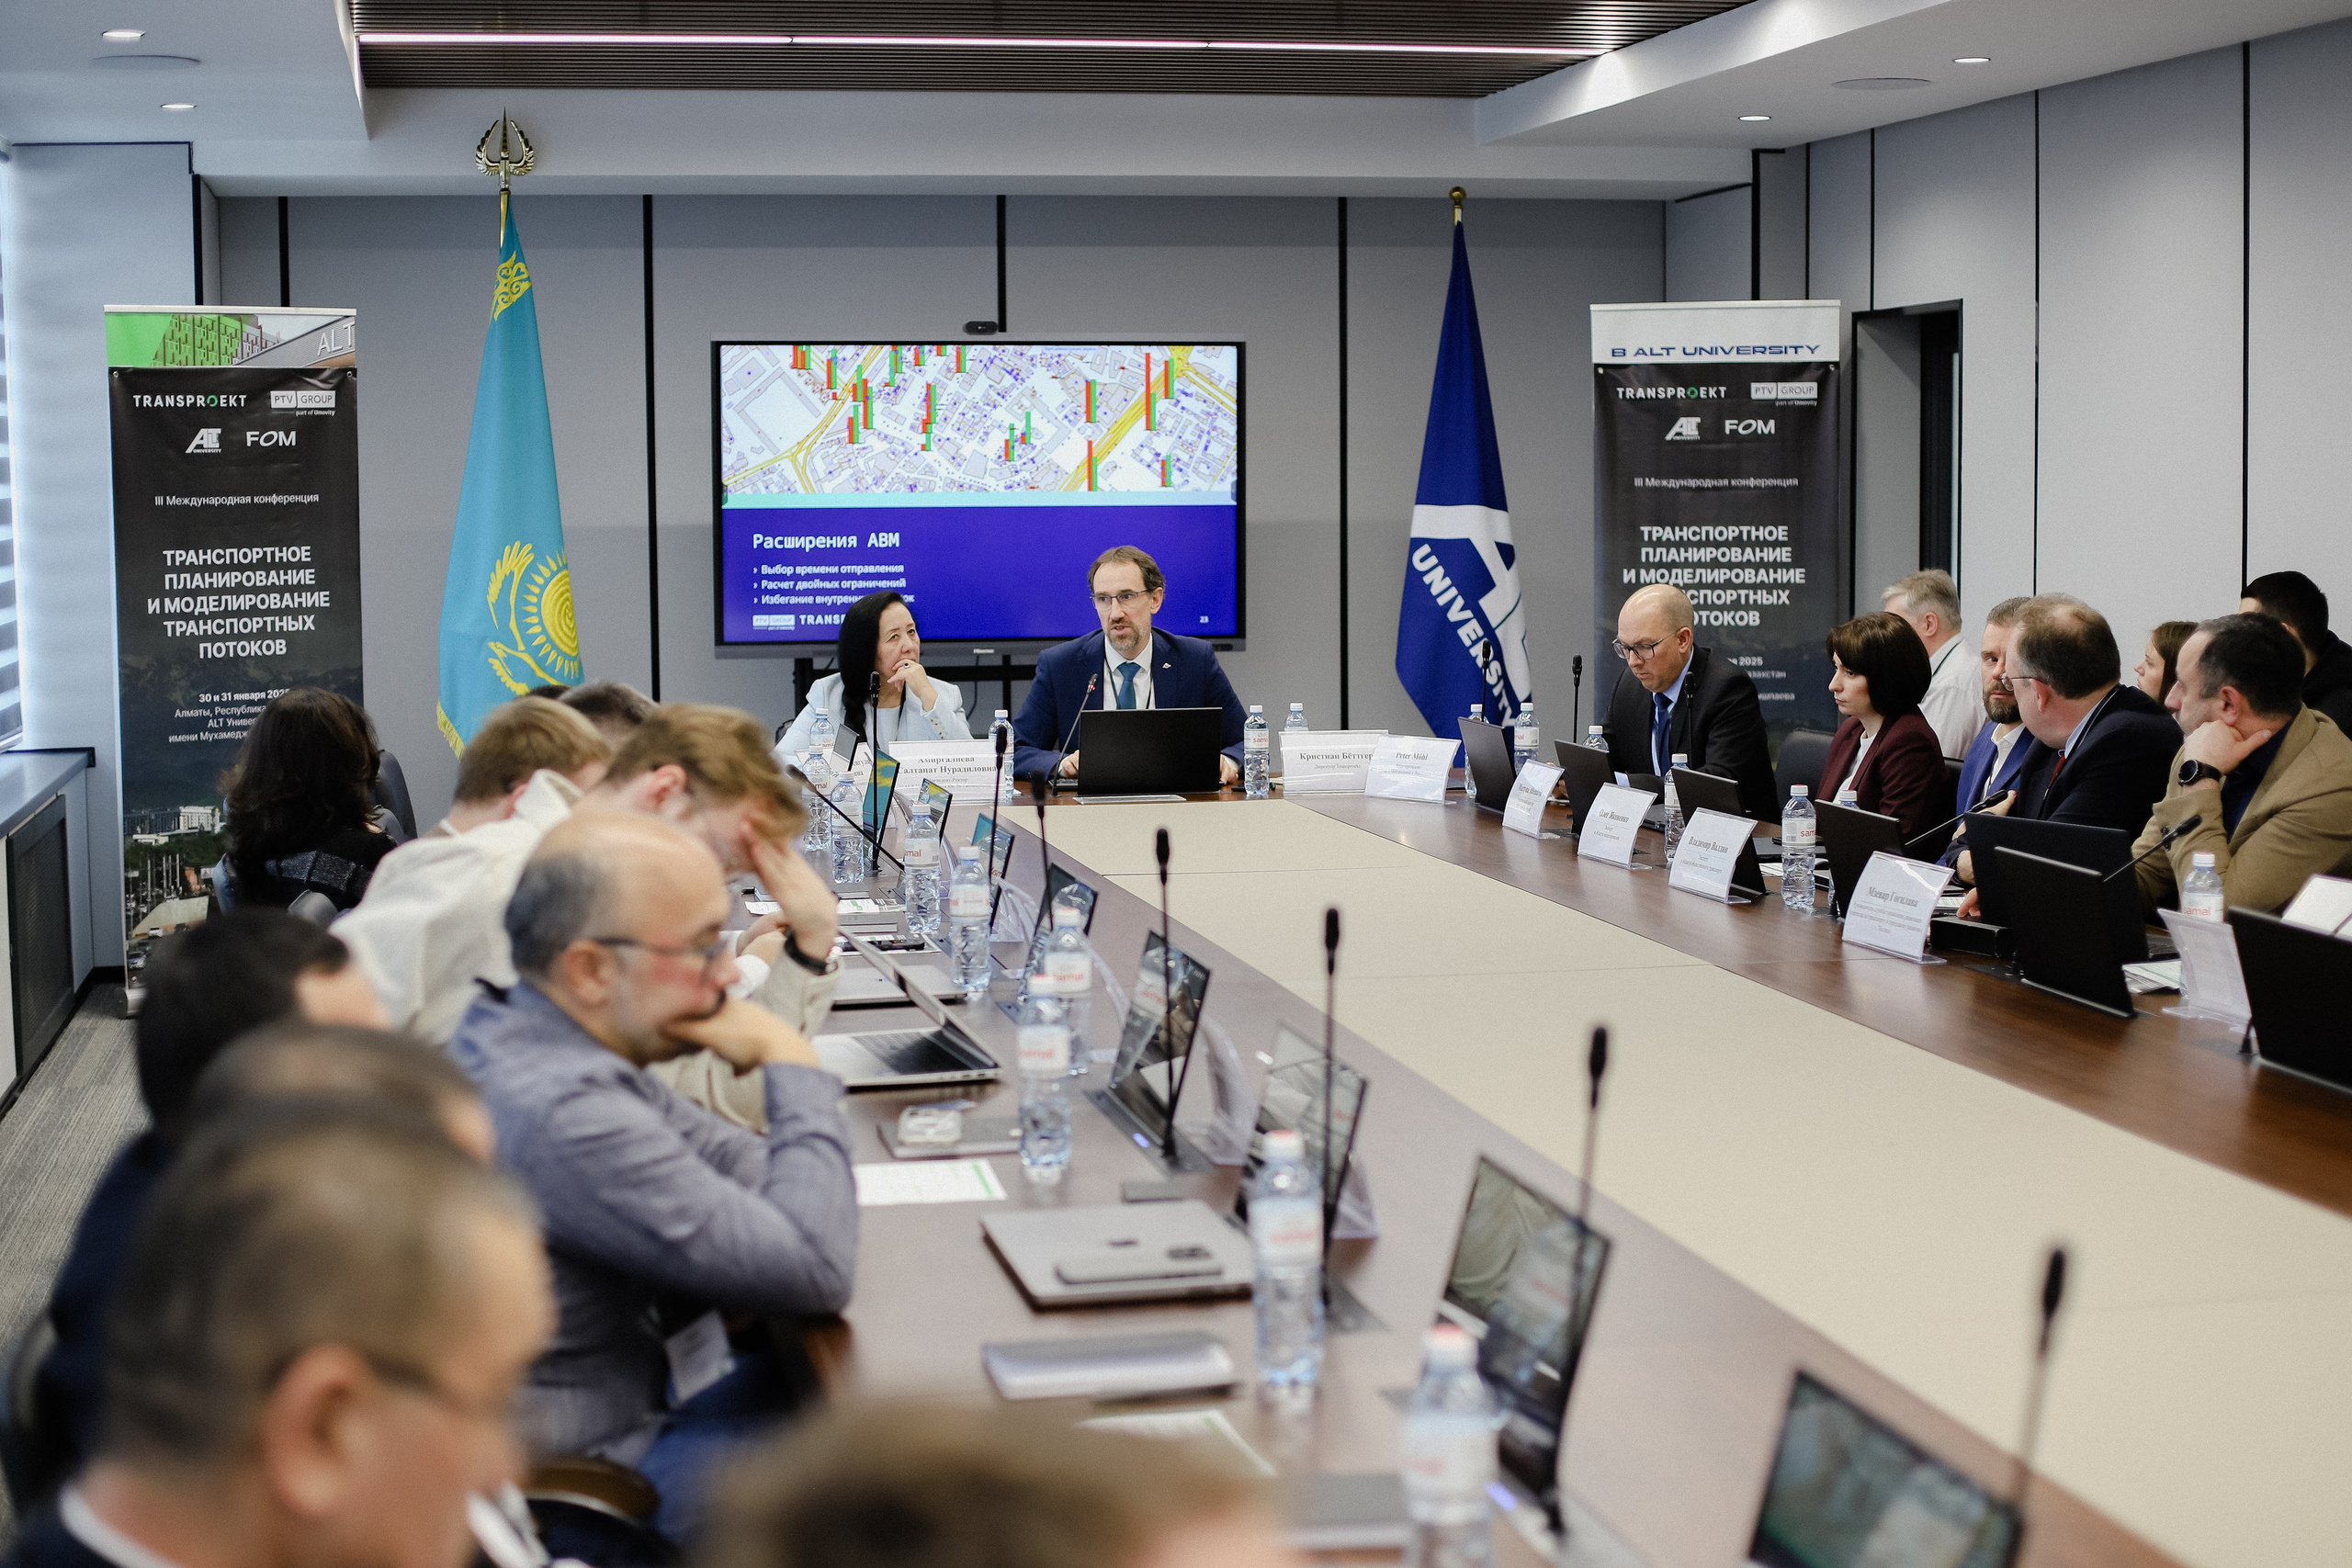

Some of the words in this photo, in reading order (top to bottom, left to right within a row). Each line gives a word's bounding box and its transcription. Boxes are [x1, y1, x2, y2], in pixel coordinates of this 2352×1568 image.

[317, 321, 355, 355] ALT
[1634, 347, 1676, 356] ALT
[1682, 344, 1820, 355] UNIVERSITY
[1617, 387, 1726, 400] TRANSPROEKT
[1755, 387, 1774, 396] PTV
[1781, 386, 1815, 395] GROUP
[133, 394, 247, 407] TRANSPROEKT
[274, 395, 293, 404] PTV
[300, 395, 333, 404] GROUP
[1724, 420, 1776, 434] FOM
[246, 431, 297, 446] FOM
[1645, 477, 1728, 489] Международная
[1731, 477, 1798, 488] конференция
[154, 495, 164, 505] III
[166, 495, 251, 507] Международная
[254, 493, 319, 505] конференция
[1640, 525, 1788, 542] ТРАНСПОРТНОЕ
[752, 533, 857, 552] Расширения
[163, 546, 311, 566] ТРАНСПОРТНОЕ
[1640, 547, 1792, 564] ПЛАНИРОВАНИЕ
[761, 564, 794, 576] Выбор
[796, 565, 839, 576] времени
[840, 564, 904, 576] отправления
[1623, 569, 1635, 583] И
[1640, 568, 1805, 585] МОДЕЛИРОВАНИЕ
[164, 569, 316, 590] ПЛАНИРОВАНИЕ
[762, 580, 795, 590] Расчет
[796, 579, 840, 591] двойных
[841, 578, 906, 591] ограничений
[762, 593, 814, 604] Избегание
[815, 595, 865, 606] внутренн
[1683, 589, 1790, 604] СПОРТНЫХ
[147, 599, 161, 614] И
[164, 592, 330, 615] МОДЕЛИРОВАНИЕ
[1694, 610, 1760, 626] ТОКОВ
[164, 615, 315, 637] ТРАНСПОРТНЫХ
[198, 638, 287, 659] ПОТОКОВ
[1738, 656, 1763, 666] 2025
[198, 694, 211, 703] 30
[220, 692, 232, 701] 31
[233, 690, 266, 701] января
[175, 708, 212, 718] Алматы,
[208, 718, 223, 728] ALT
[169, 734, 198, 742] имени
[918, 756, 975, 764] Амиргалиева
[1300, 752, 1340, 761] Кристиан
[940, 765, 997, 774] Нурадиловна
[904, 849, 922, 857] amal
[2184, 906, 2211, 917] samal
